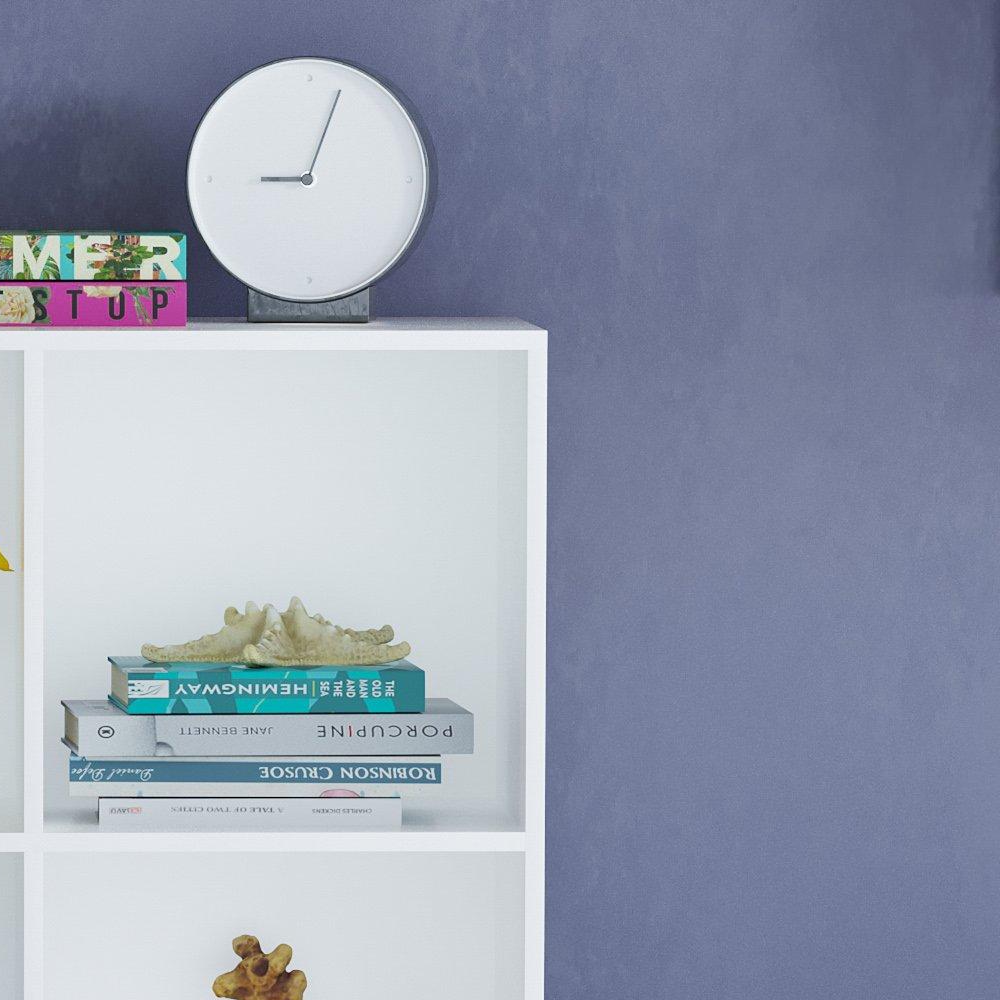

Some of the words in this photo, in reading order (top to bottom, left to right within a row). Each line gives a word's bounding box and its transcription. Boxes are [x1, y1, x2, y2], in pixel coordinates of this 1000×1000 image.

[34, 285, 169, 321] STOP
[175, 683, 307, 695] HEMINGWAY
[320, 681, 330, 697] SEA
[333, 680, 343, 697] THE
[345, 679, 356, 698] AND
[358, 679, 369, 698] MAN
[371, 679, 382, 698] OLD
[385, 680, 395, 697] THE
[179, 726, 238, 735] BENNETT
[242, 726, 274, 735] JANE
[317, 725, 453, 738] PORCUPINE
[71, 762, 106, 782] Defoe
[106, 767, 154, 781] Daniel
[259, 766, 333, 780] CRUSOE
[340, 767, 437, 781] ROBINSON
